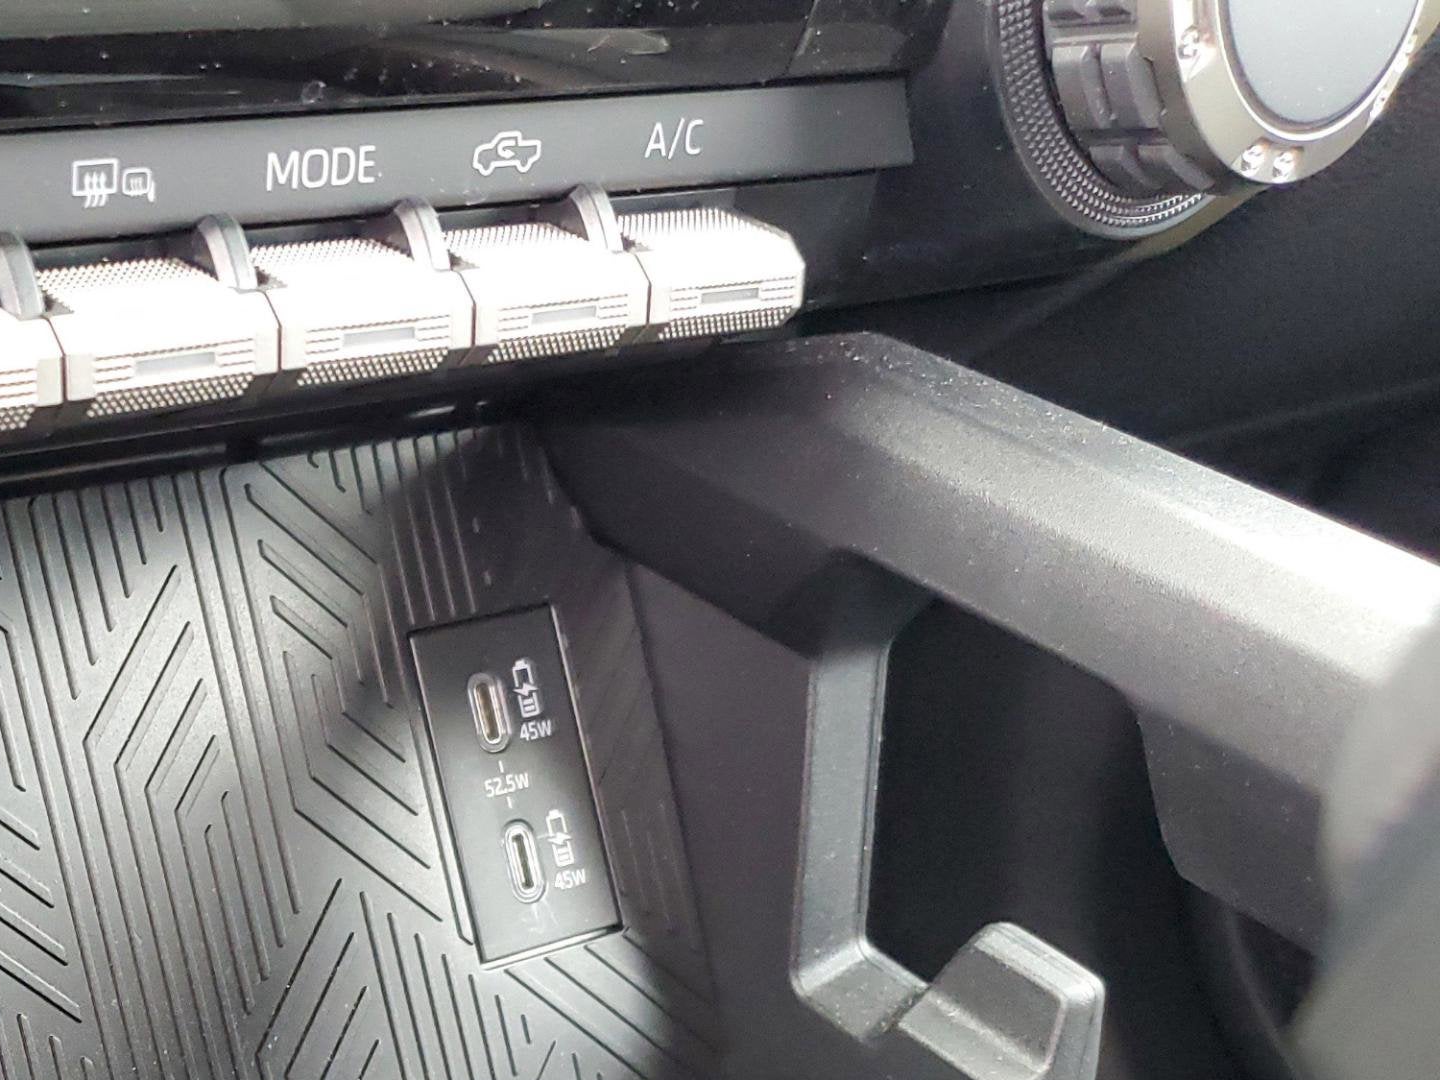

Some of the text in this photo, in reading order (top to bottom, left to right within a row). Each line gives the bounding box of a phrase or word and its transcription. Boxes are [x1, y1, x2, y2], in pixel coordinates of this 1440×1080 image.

[644, 117, 704, 160] A/C
[266, 144, 377, 192] MODE
[519, 720, 552, 741] 45W
[484, 773, 529, 798] 52.5W
[554, 868, 587, 890] 45W
